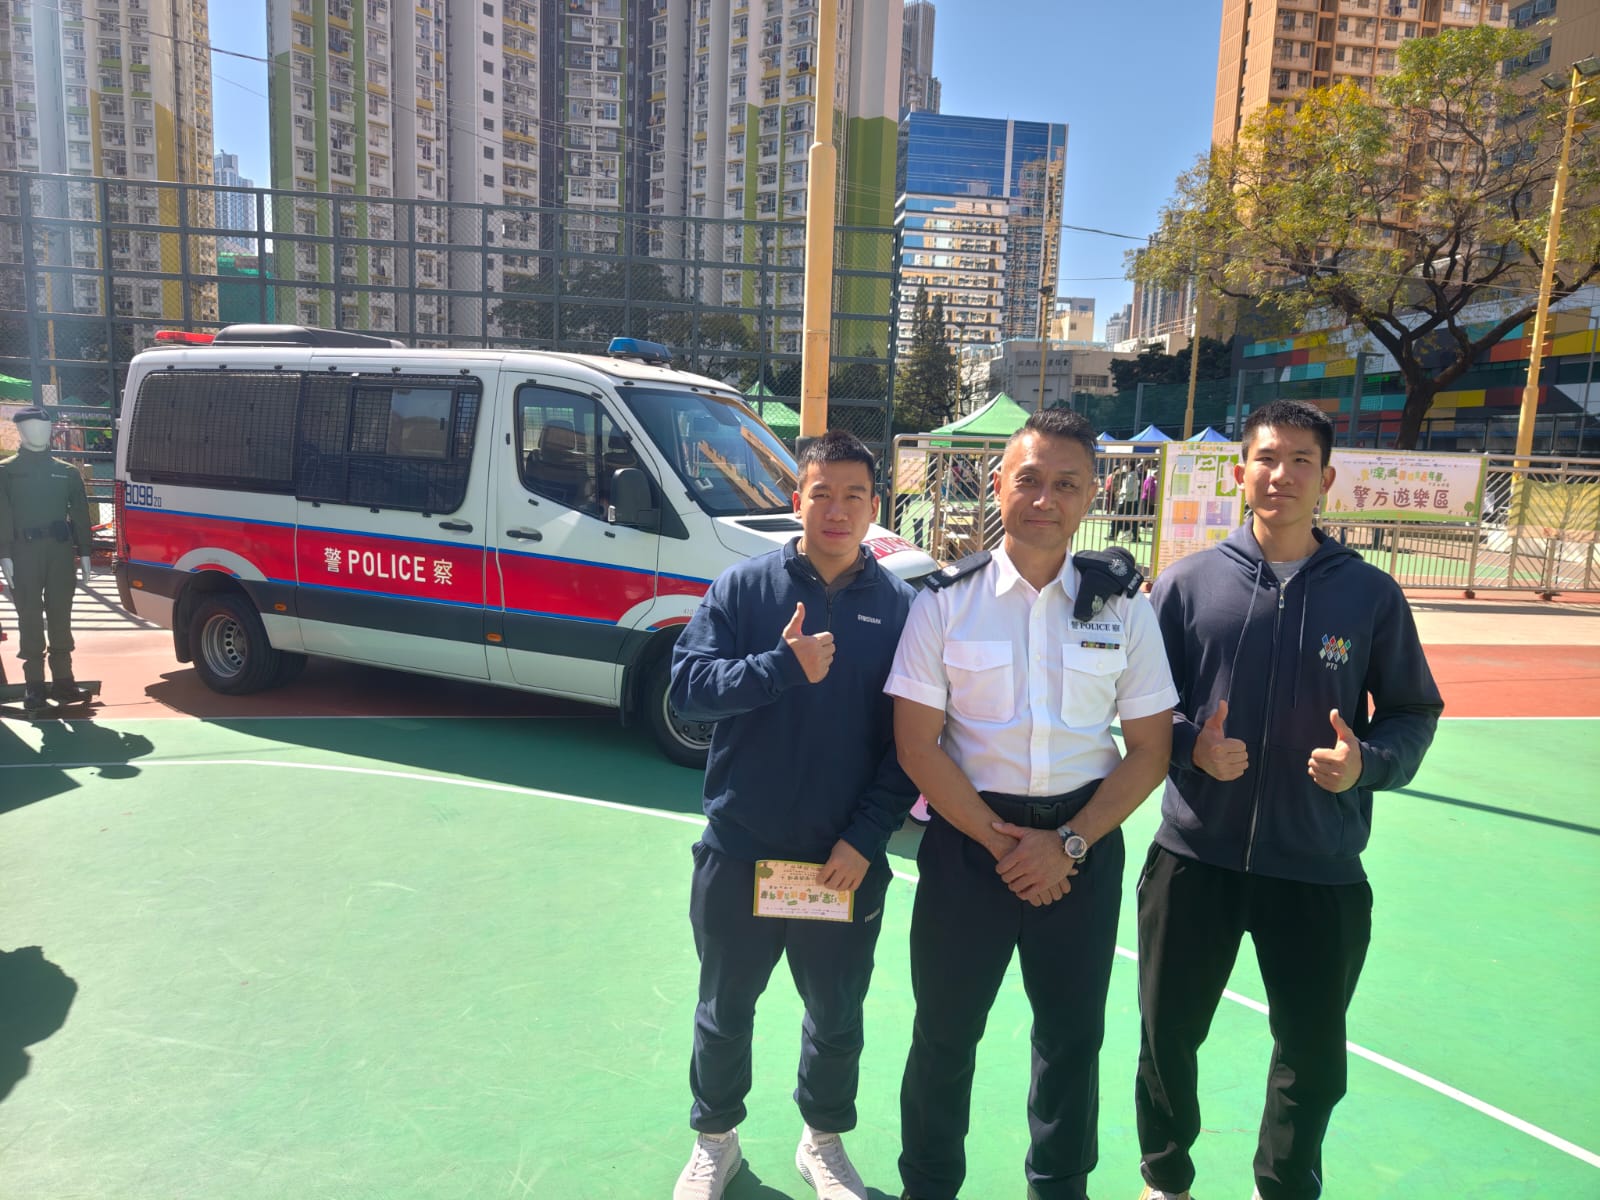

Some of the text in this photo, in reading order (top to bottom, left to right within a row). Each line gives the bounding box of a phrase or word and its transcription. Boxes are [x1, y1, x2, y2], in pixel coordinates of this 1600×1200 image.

[1353, 485, 1449, 509] 警方遊樂區
[324, 547, 453, 585] 警 POLICE 察
[1080, 622, 1111, 632] POLICE
